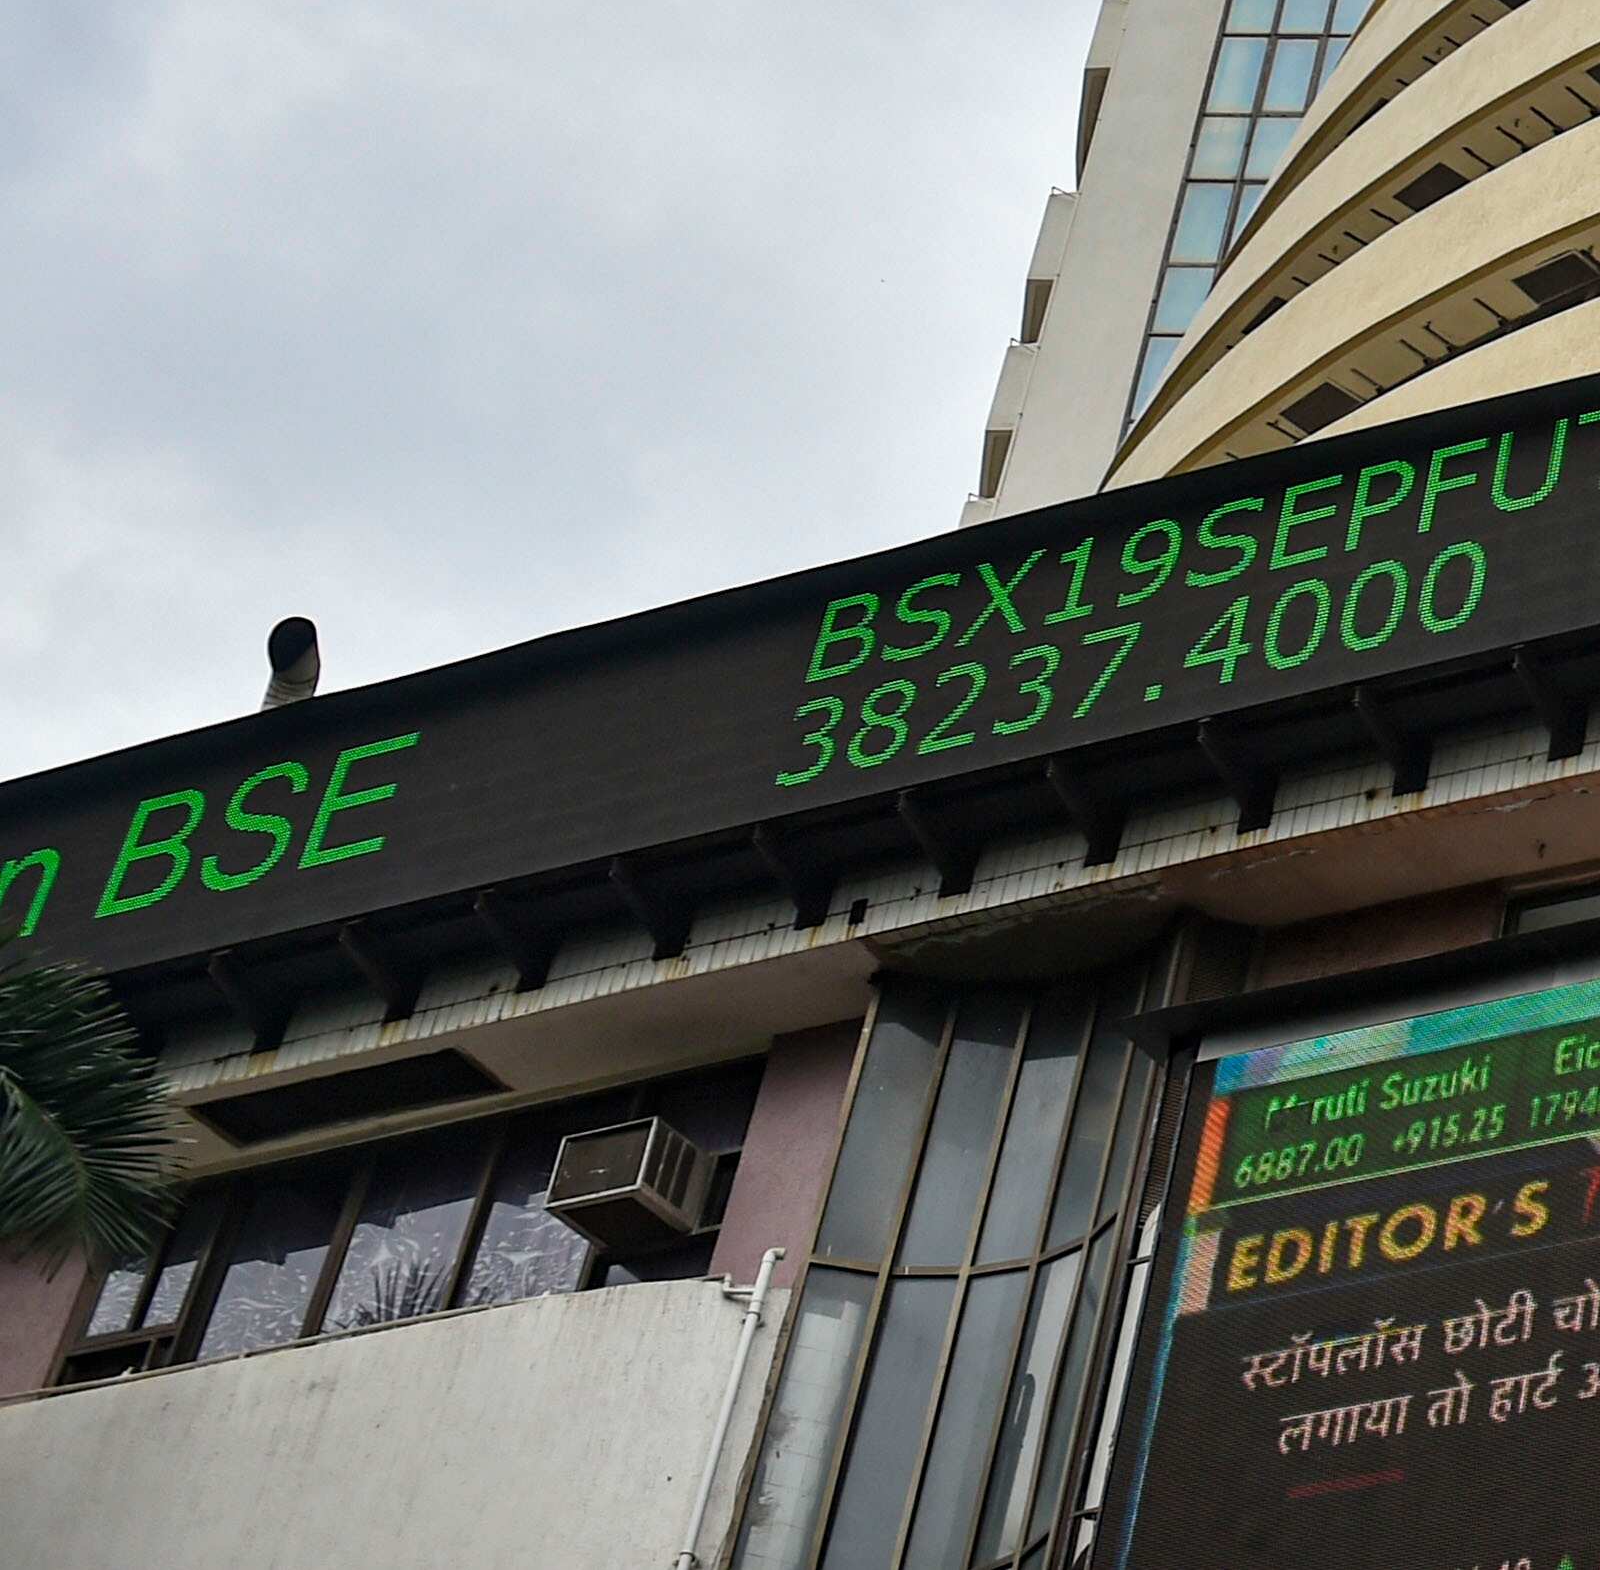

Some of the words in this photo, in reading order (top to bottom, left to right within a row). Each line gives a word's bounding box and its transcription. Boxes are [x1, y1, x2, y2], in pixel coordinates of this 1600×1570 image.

[774, 540, 1489, 788] 38237.4000
[95, 731, 421, 919] BSE
[1380, 1054, 1494, 1111] Suzuki
[1234, 1133, 1366, 1189] 6887.00
[1442, 1290, 1537, 1355] छोटी
[1277, 1394, 1414, 1456] लगाया
[1427, 1371, 1475, 1428] तो
